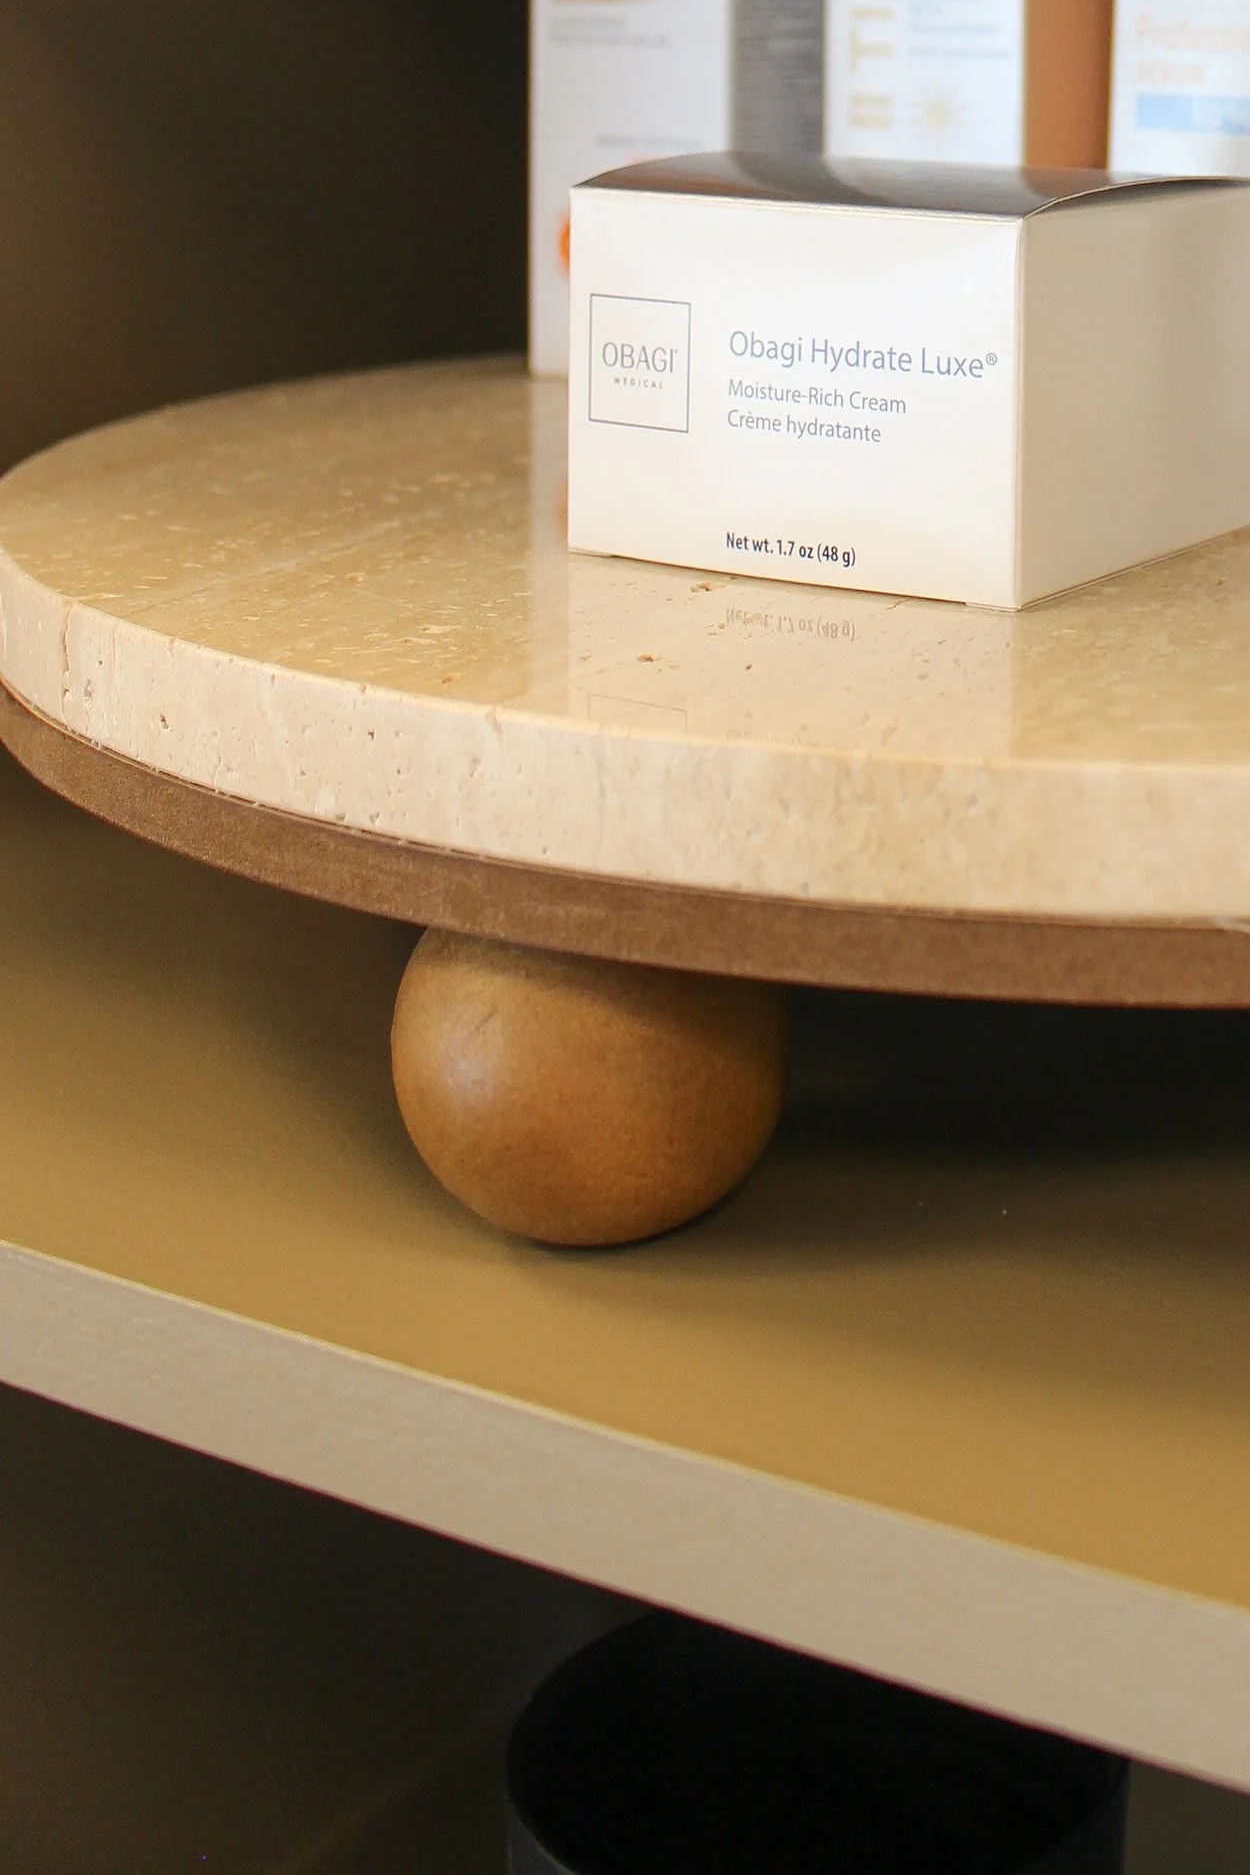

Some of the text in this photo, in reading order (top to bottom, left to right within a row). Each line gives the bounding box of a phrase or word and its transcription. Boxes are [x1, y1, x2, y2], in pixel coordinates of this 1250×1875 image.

[729, 330, 998, 379] Obagi Hydrate Luxe®
[614, 377, 664, 390] MEDICAL
[728, 378, 907, 414] Moisture-Rich Cream
[727, 409, 882, 443] Crème hydratante
[726, 531, 856, 568] Net wt. 1.7 oz (48 g)
